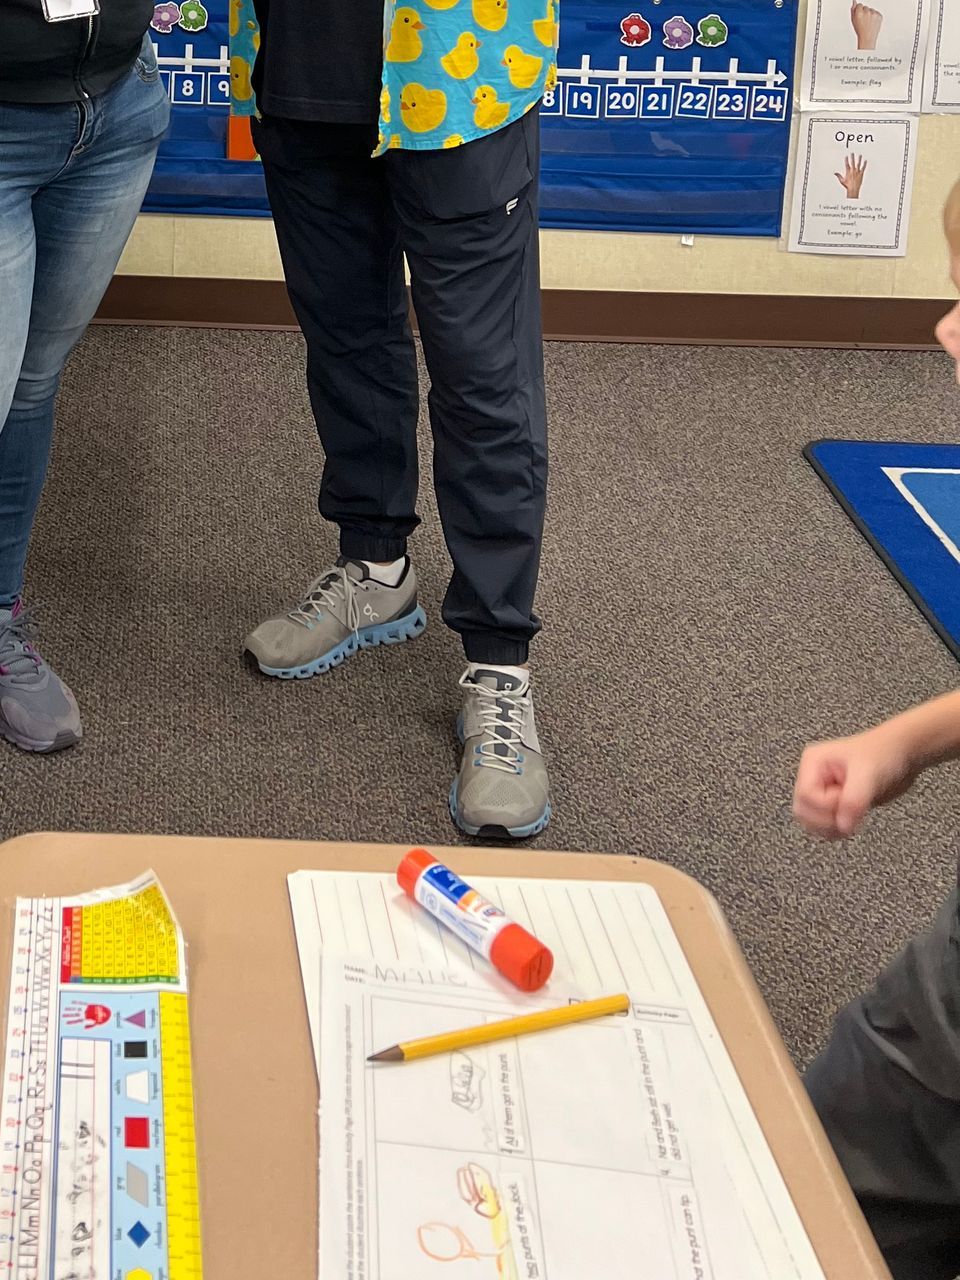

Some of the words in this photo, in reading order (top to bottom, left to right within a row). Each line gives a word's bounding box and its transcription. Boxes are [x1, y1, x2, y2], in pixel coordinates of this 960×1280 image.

[894, 57, 902, 65] by
[181, 78, 195, 96] 8
[840, 79, 867, 87] Example:
[868, 79, 882, 88] flag
[541, 91, 556, 108] 8
[573, 93, 592, 111] 19
[608, 94, 635, 111] 20
[647, 93, 669, 111] 21
[681, 92, 708, 111] 22
[718, 94, 744, 112] 23
[754, 94, 782, 113] 24
[835, 130, 875, 148] Open
